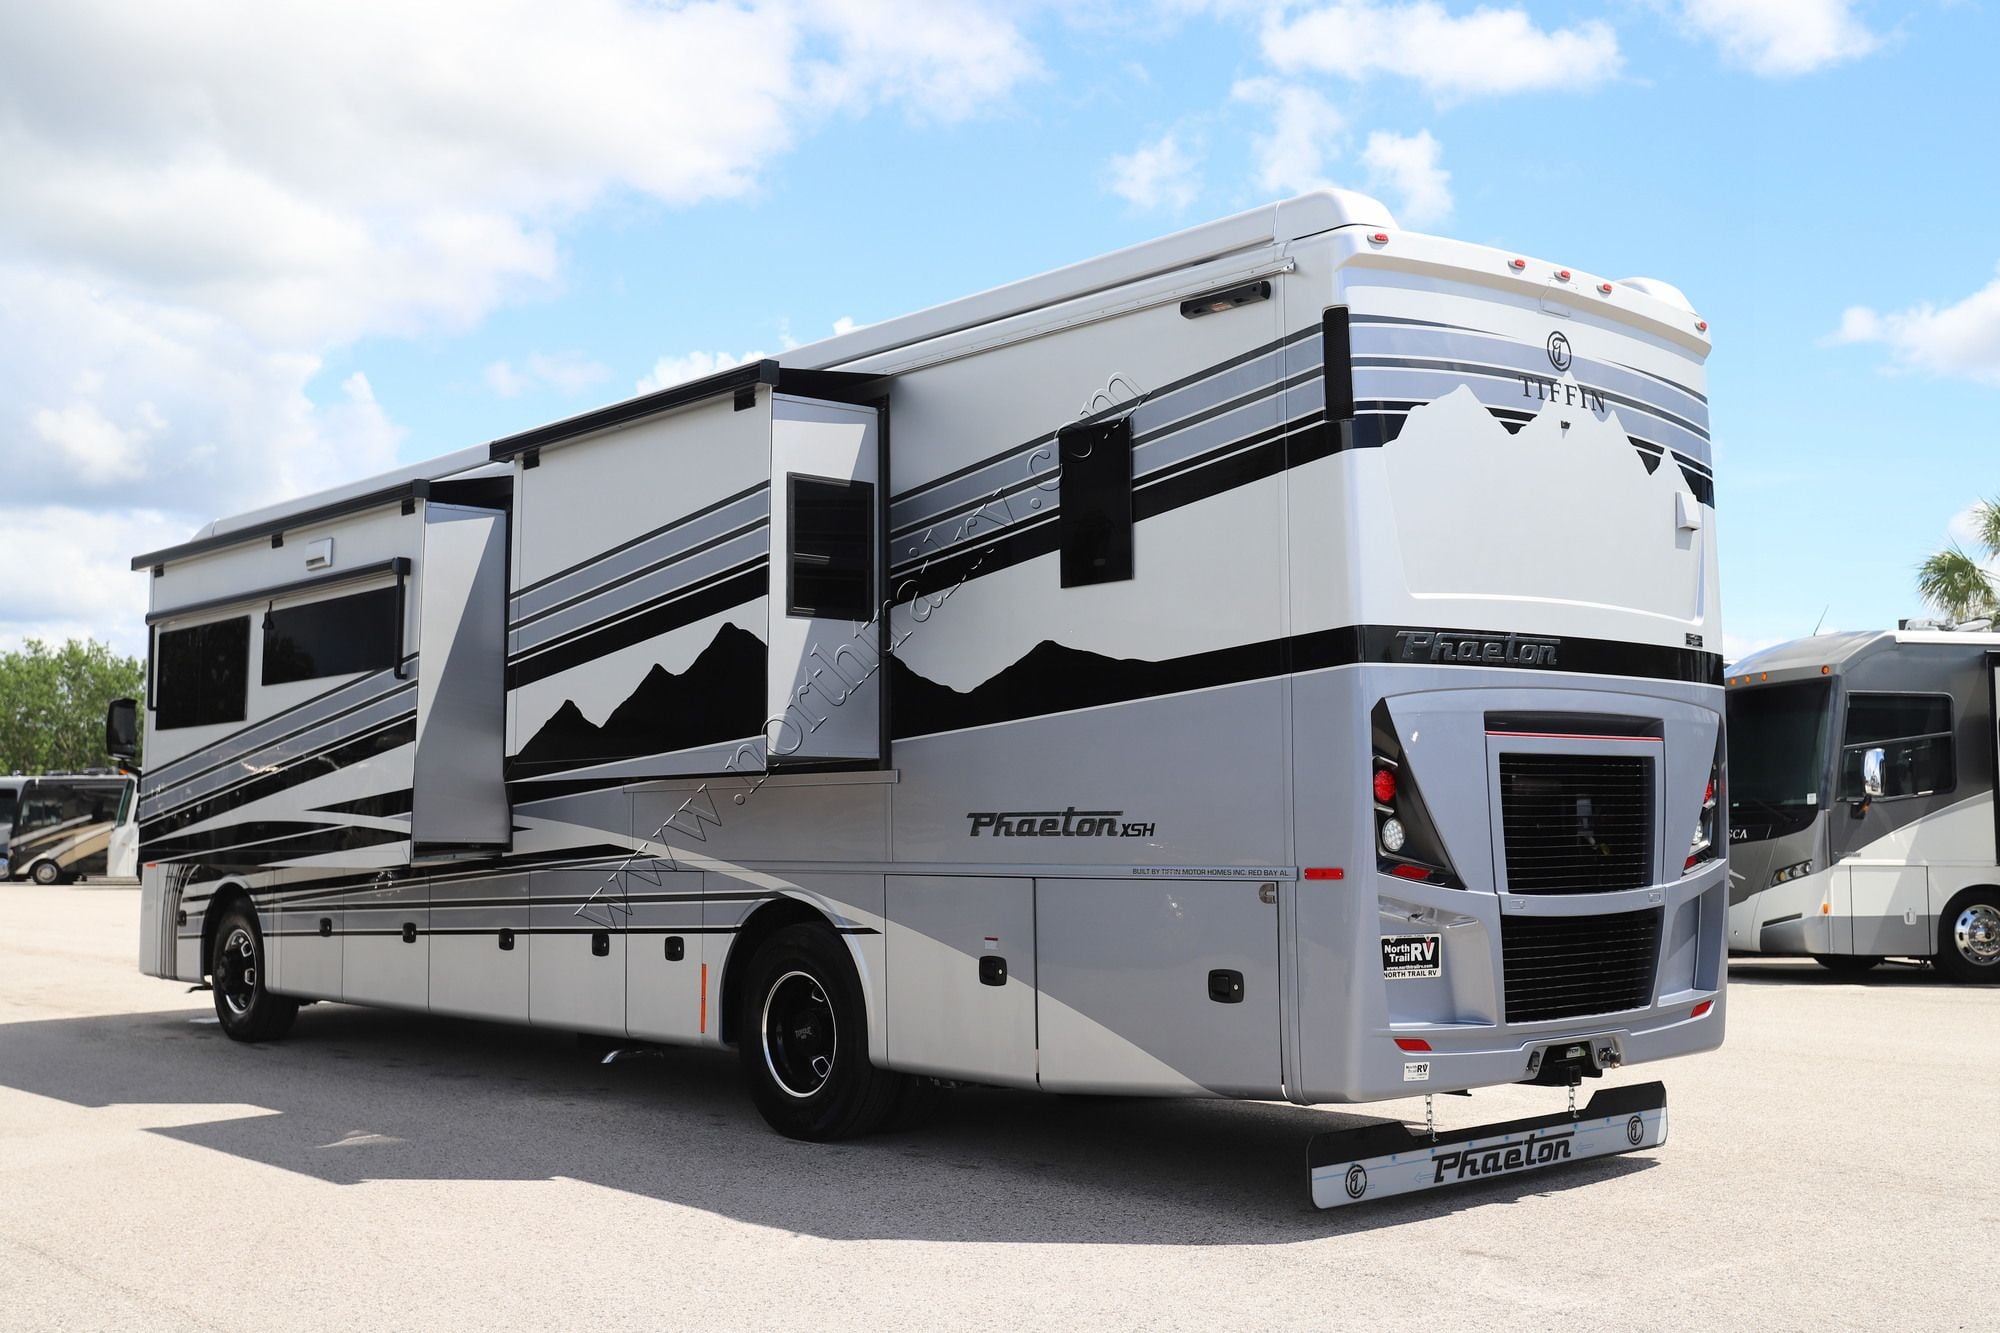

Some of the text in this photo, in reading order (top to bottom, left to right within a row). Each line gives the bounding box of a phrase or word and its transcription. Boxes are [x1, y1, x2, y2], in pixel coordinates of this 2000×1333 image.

[1518, 375, 1605, 413] TIFFIN
[1395, 630, 1561, 665] Phaeton
[967, 806, 1155, 837] Phaeton XSH
[1182, 868, 1206, 876] MOTOR
[1384, 942, 1435, 962] North RV
[1389, 953, 1410, 963] Trail
[1417, 1063, 1428, 1073] RV
[1432, 1131, 1575, 1184] Phaeton
